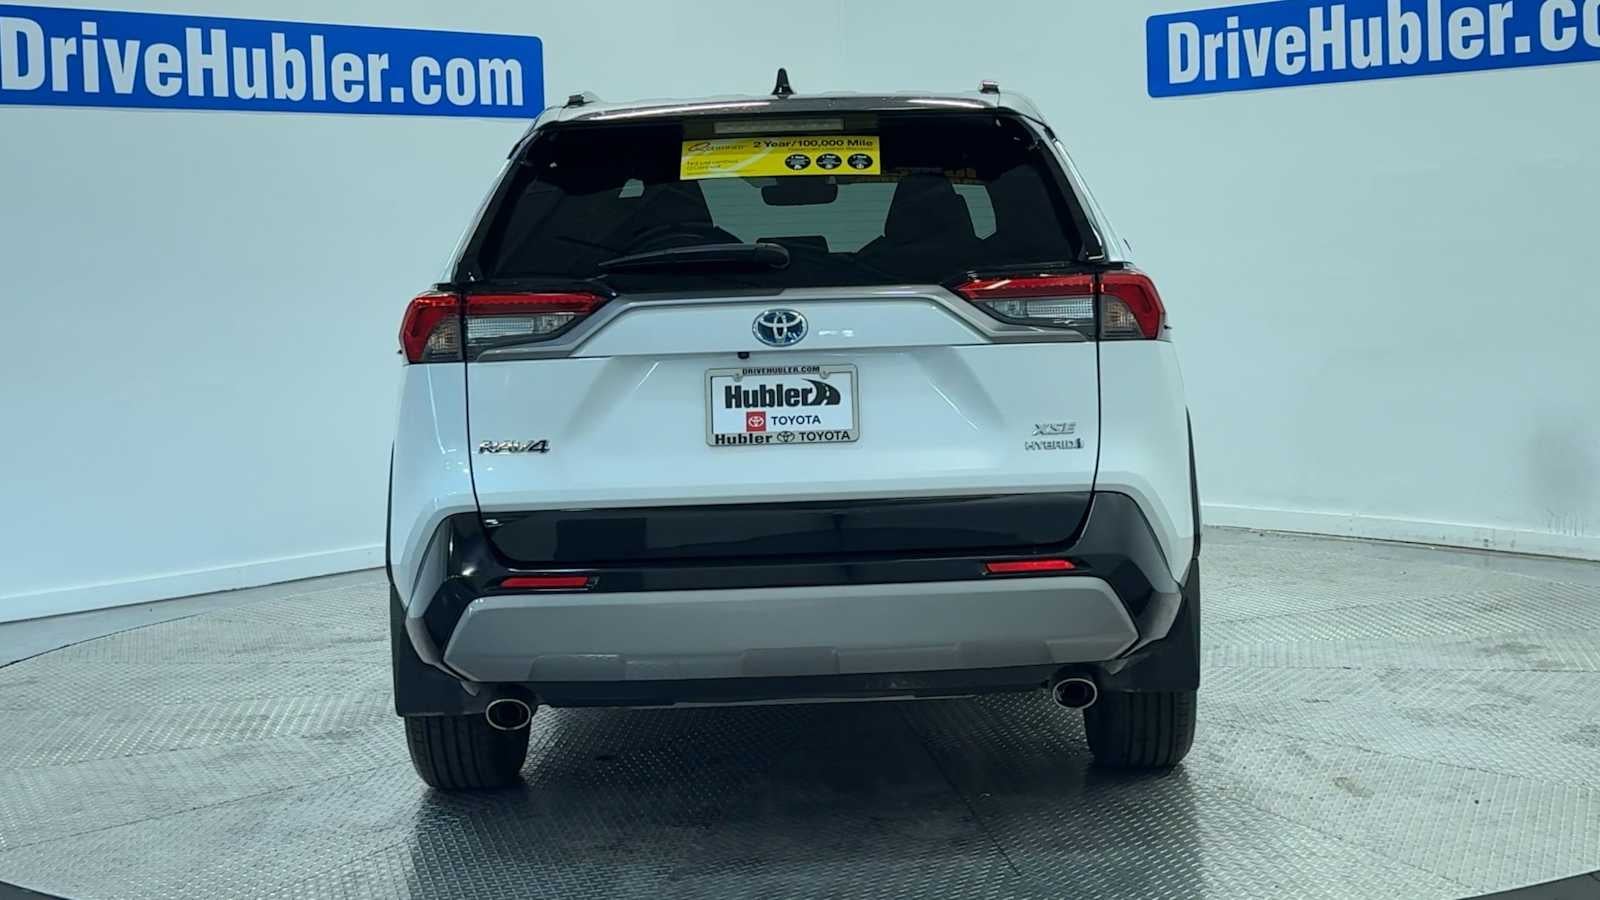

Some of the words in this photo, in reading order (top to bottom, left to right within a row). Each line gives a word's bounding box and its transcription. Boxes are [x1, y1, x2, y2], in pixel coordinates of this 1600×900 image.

[0, 16, 524, 106] DriveHubler.com
[764, 139, 844, 148] Year/100,000
[847, 139, 873, 147] Mile
[742, 365, 820, 375] DRIVEHUBLER.COM
[725, 384, 813, 408] Hubler
[771, 415, 821, 425] TOYOTA
[1032, 422, 1076, 436] XSE
[715, 433, 772, 445] Hubler
[799, 431, 850, 442] TOYOTA
[479, 440, 550, 454] RAV4
